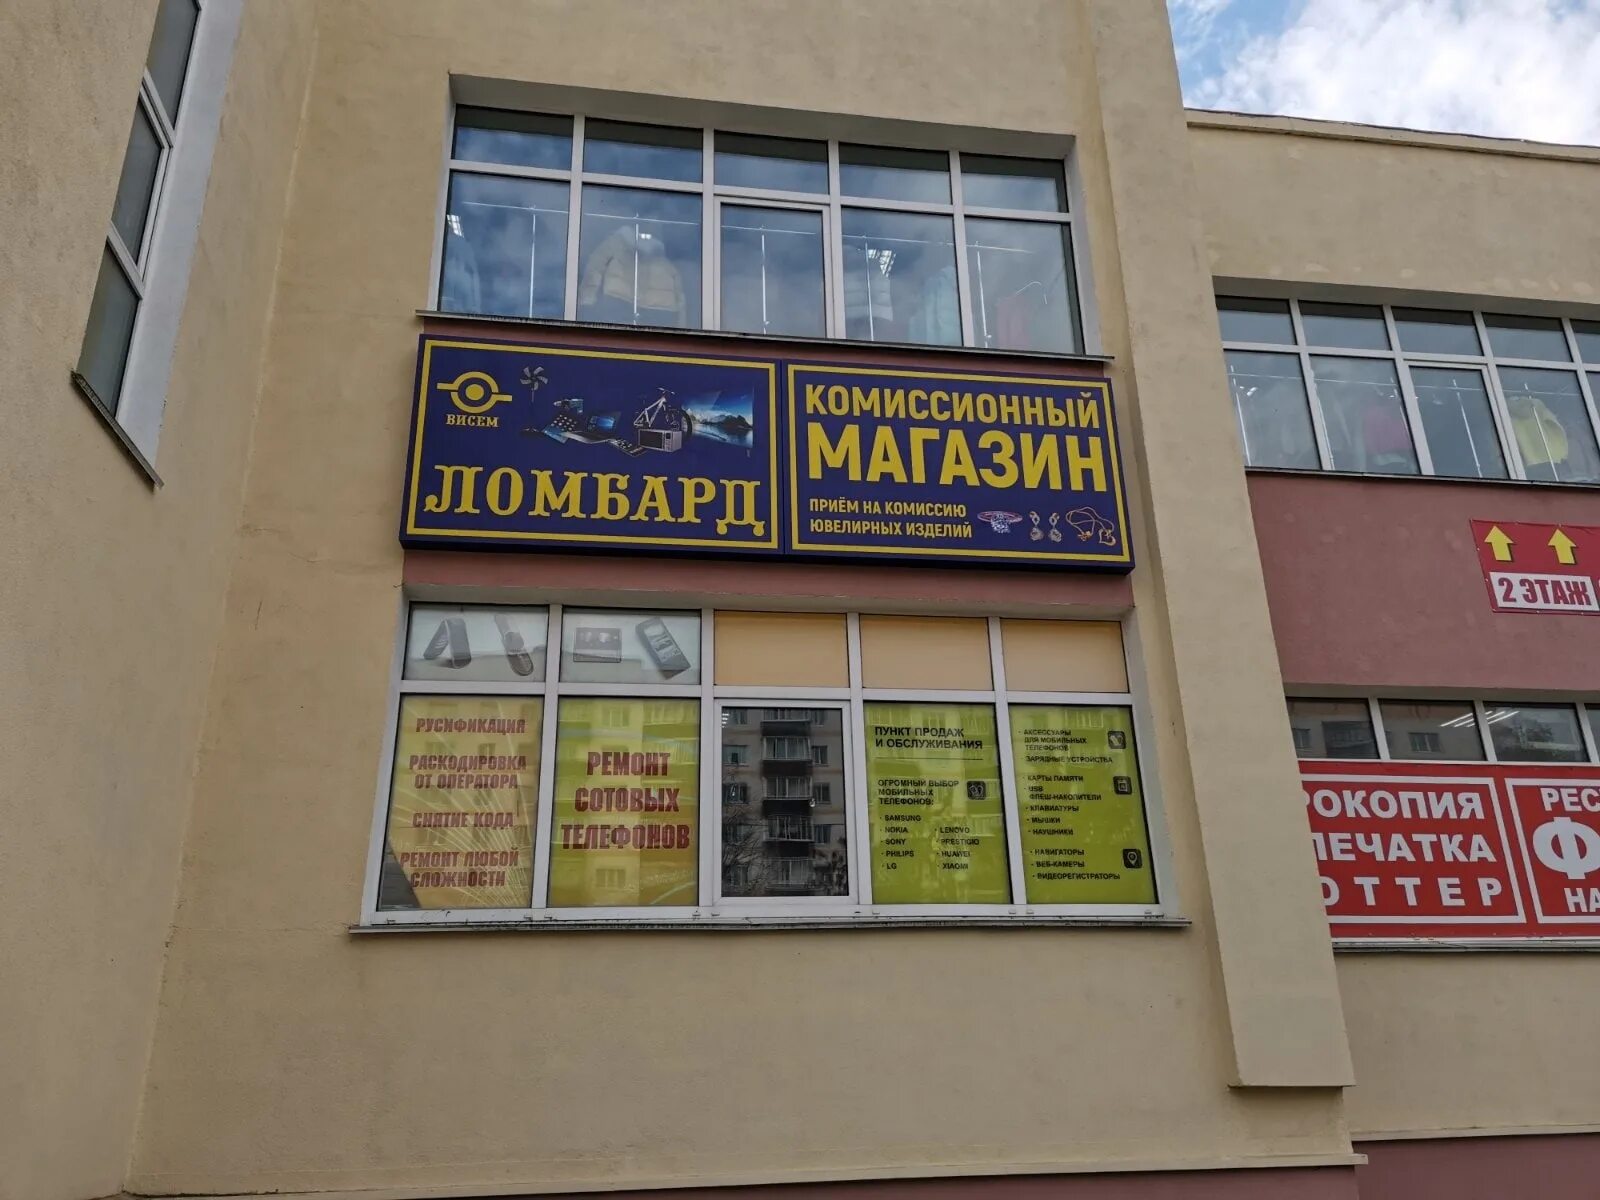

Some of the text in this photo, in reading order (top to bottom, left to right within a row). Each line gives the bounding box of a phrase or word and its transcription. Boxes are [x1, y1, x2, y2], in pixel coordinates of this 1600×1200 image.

[805, 383, 1100, 429] КОМИССИОННЫЙ
[445, 413, 499, 428] ВИСЕМ
[807, 422, 1107, 492] МАГАЗИН
[423, 464, 766, 537] ЛОМБАРД
[809, 496, 967, 519] ПРИЁМ НА КОМИССИЮ
[810, 518, 973, 539] ЮВЕЛИРНЫХ ИЗДЕЛИЙ
[1498, 577, 1517, 603] 2
[1519, 578, 1592, 606] ЭТАЖ
[415, 717, 526, 735] РУСИФИКАЦИЯ
[874, 726, 964, 738] ПУНКТ ПРОДАЖ
[875, 738, 983, 750] И ОБСЛУЖИВАНИЯ
[1025, 744, 1069, 752] ТЕЛЕФОНОВ
[409, 754, 527, 772] РАСКОДИРОВКА
[586, 751, 671, 777] РЕМОНТ
[1025, 755, 1113, 764] ЗАРЯДНЫЕ УСТРОЙСТВА
[414, 773, 518, 790] ОТ ОПЕРАТОРА
[1027, 774, 1053, 782] КАРТЫ
[928, 780, 960, 788] ВЫБОР
[878, 788, 934, 796] МОБИЛЬНЫХ
[573, 787, 680, 813] СОТОВЫХ
[879, 797, 934, 806] ТЕЛЕФОНОВ:
[1540, 787, 1600, 812] РЕС
[1030, 804, 1080, 812] КЛАВИАТУРЫ
[412, 811, 514, 830] СНЯТИЕ КОДА
[884, 814, 922, 822] SAMSUNG
[1031, 816, 1061, 824] МЫШКИ
[884, 826, 909, 834] NOKIA
[939, 826, 970, 834] LENOVO
[1032, 828, 1074, 836] НАУШНИКИ
[560, 824, 690, 850] ТЕЛЕФОНОВ
[885, 838, 907, 846] SONY
[940, 838, 980, 846] PRESTIGIO
[885, 850, 915, 858] PHILIPS
[941, 850, 971, 858] HUAWEI
[1034, 848, 1085, 856] НАВИГАТОРЫ
[400, 846, 520, 868] РЕМОНТ ЛЮБОЙ
[886, 862, 897, 870] LG
[942, 862, 969, 870] XIAOMI
[1036, 860, 1085, 868] ВЕБ-КАМЕРЫ
[410, 870, 506, 888] СЛОЖНОСТИ
[1037, 872, 1121, 881] ВИДЕОРЕГИСТРАТОРЫ
